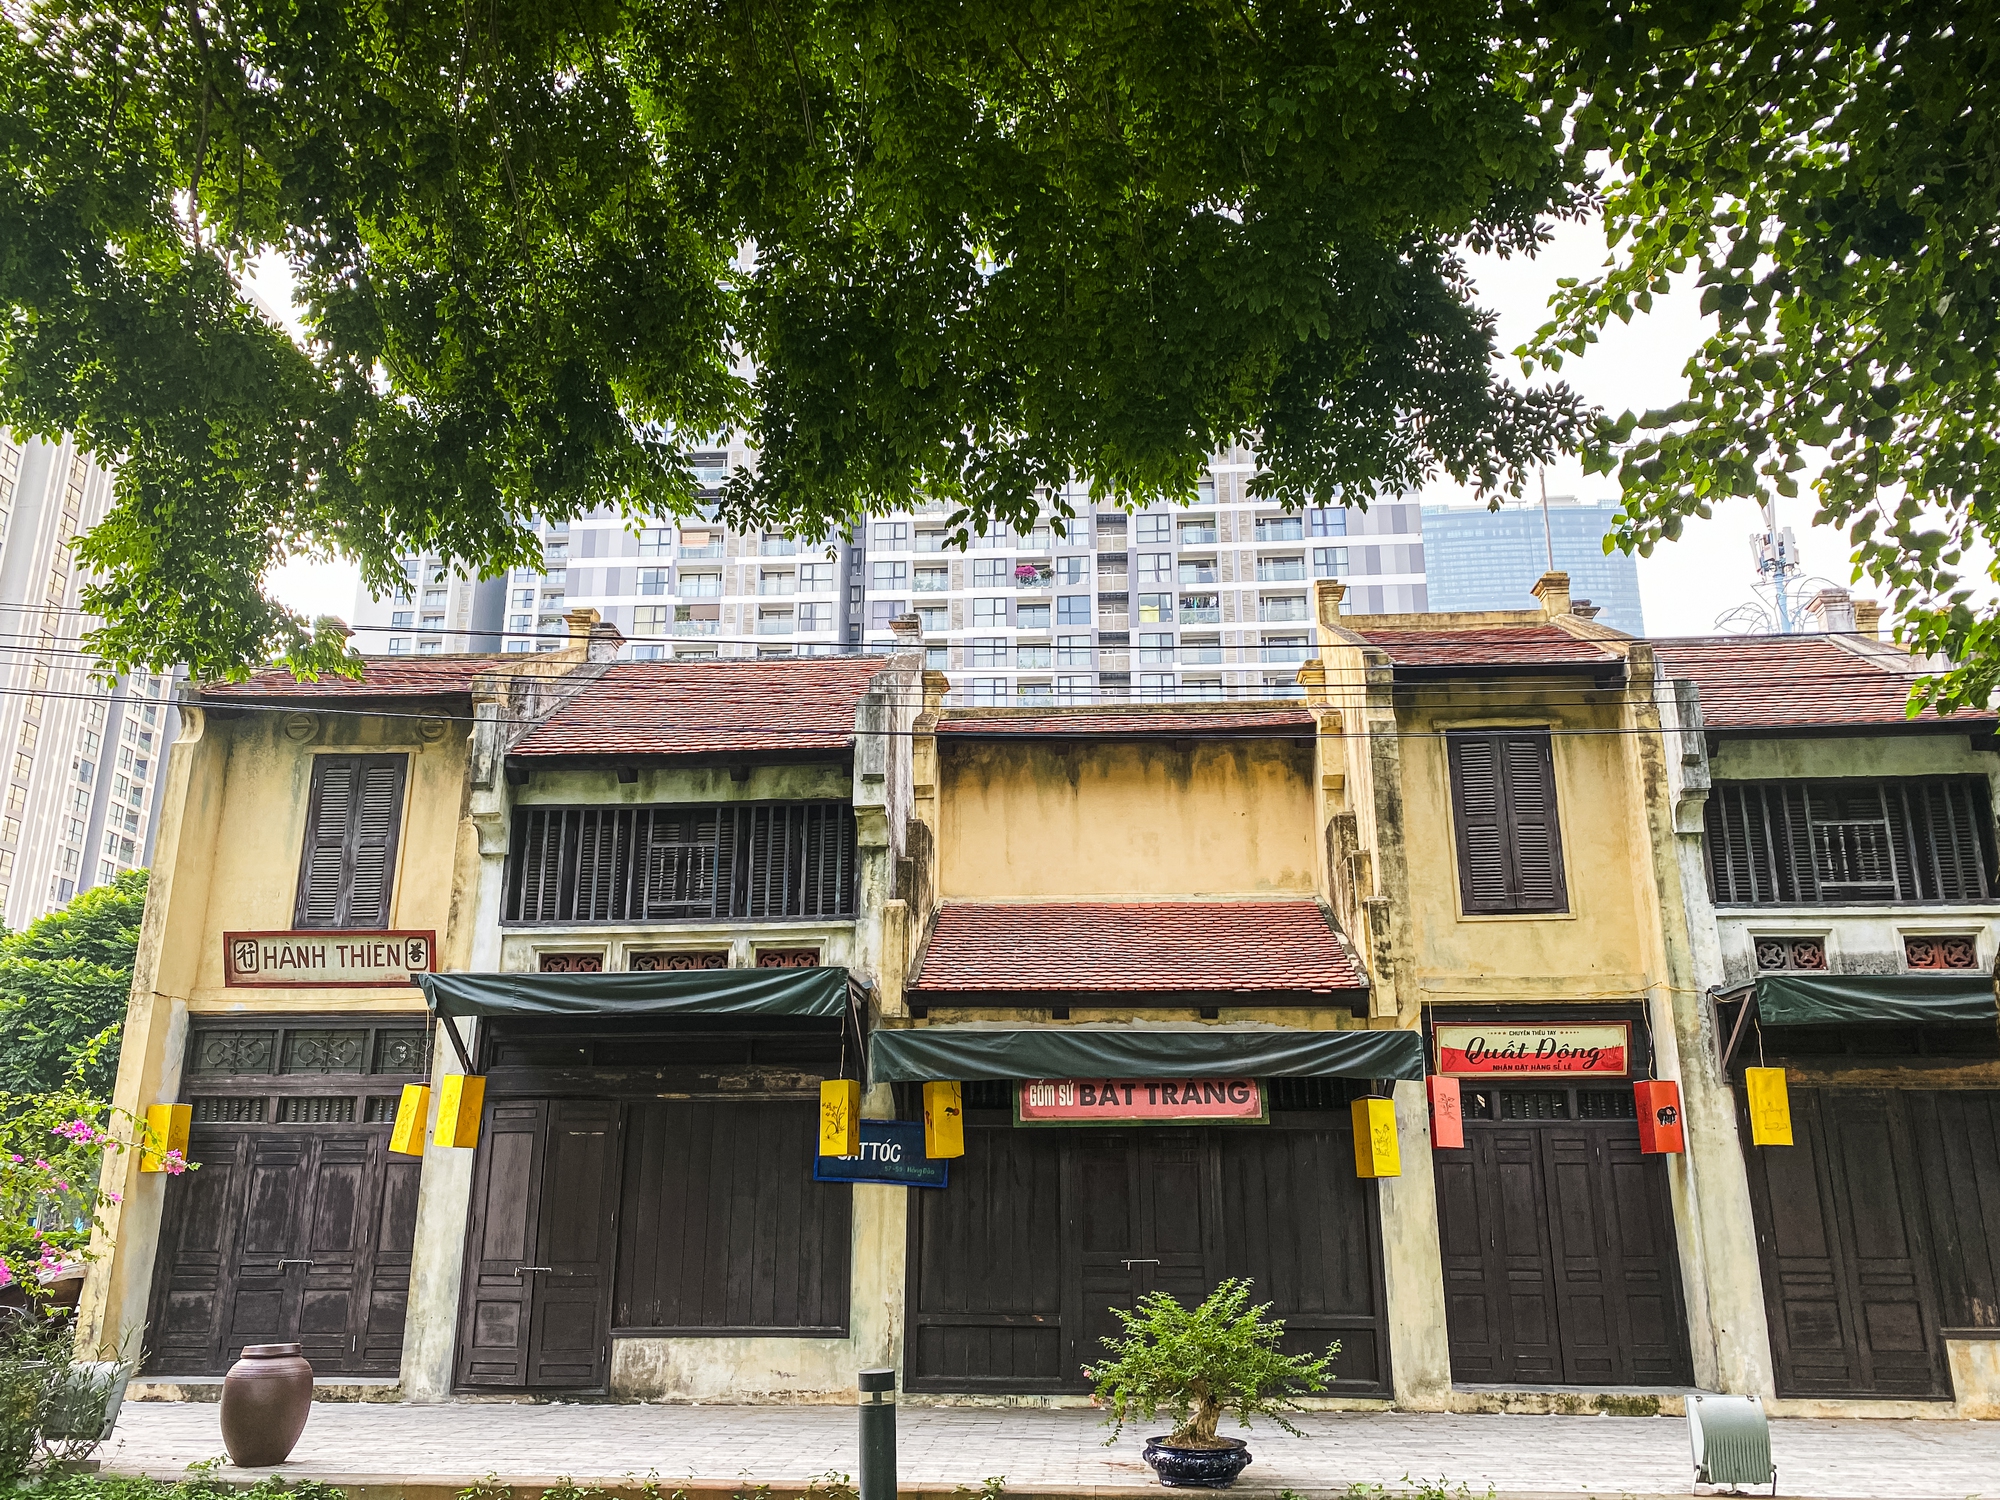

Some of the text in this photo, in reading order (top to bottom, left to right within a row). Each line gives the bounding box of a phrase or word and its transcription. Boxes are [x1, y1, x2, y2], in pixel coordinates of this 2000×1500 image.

[236, 943, 256, 969] 行
[263, 941, 326, 970] HÀNH
[1464, 1036, 1530, 1065] Quất
[1029, 1078, 1055, 1107] GỐM
[1058, 1079, 1075, 1106] SỨ
[1079, 1078, 1136, 1106] BÁT
